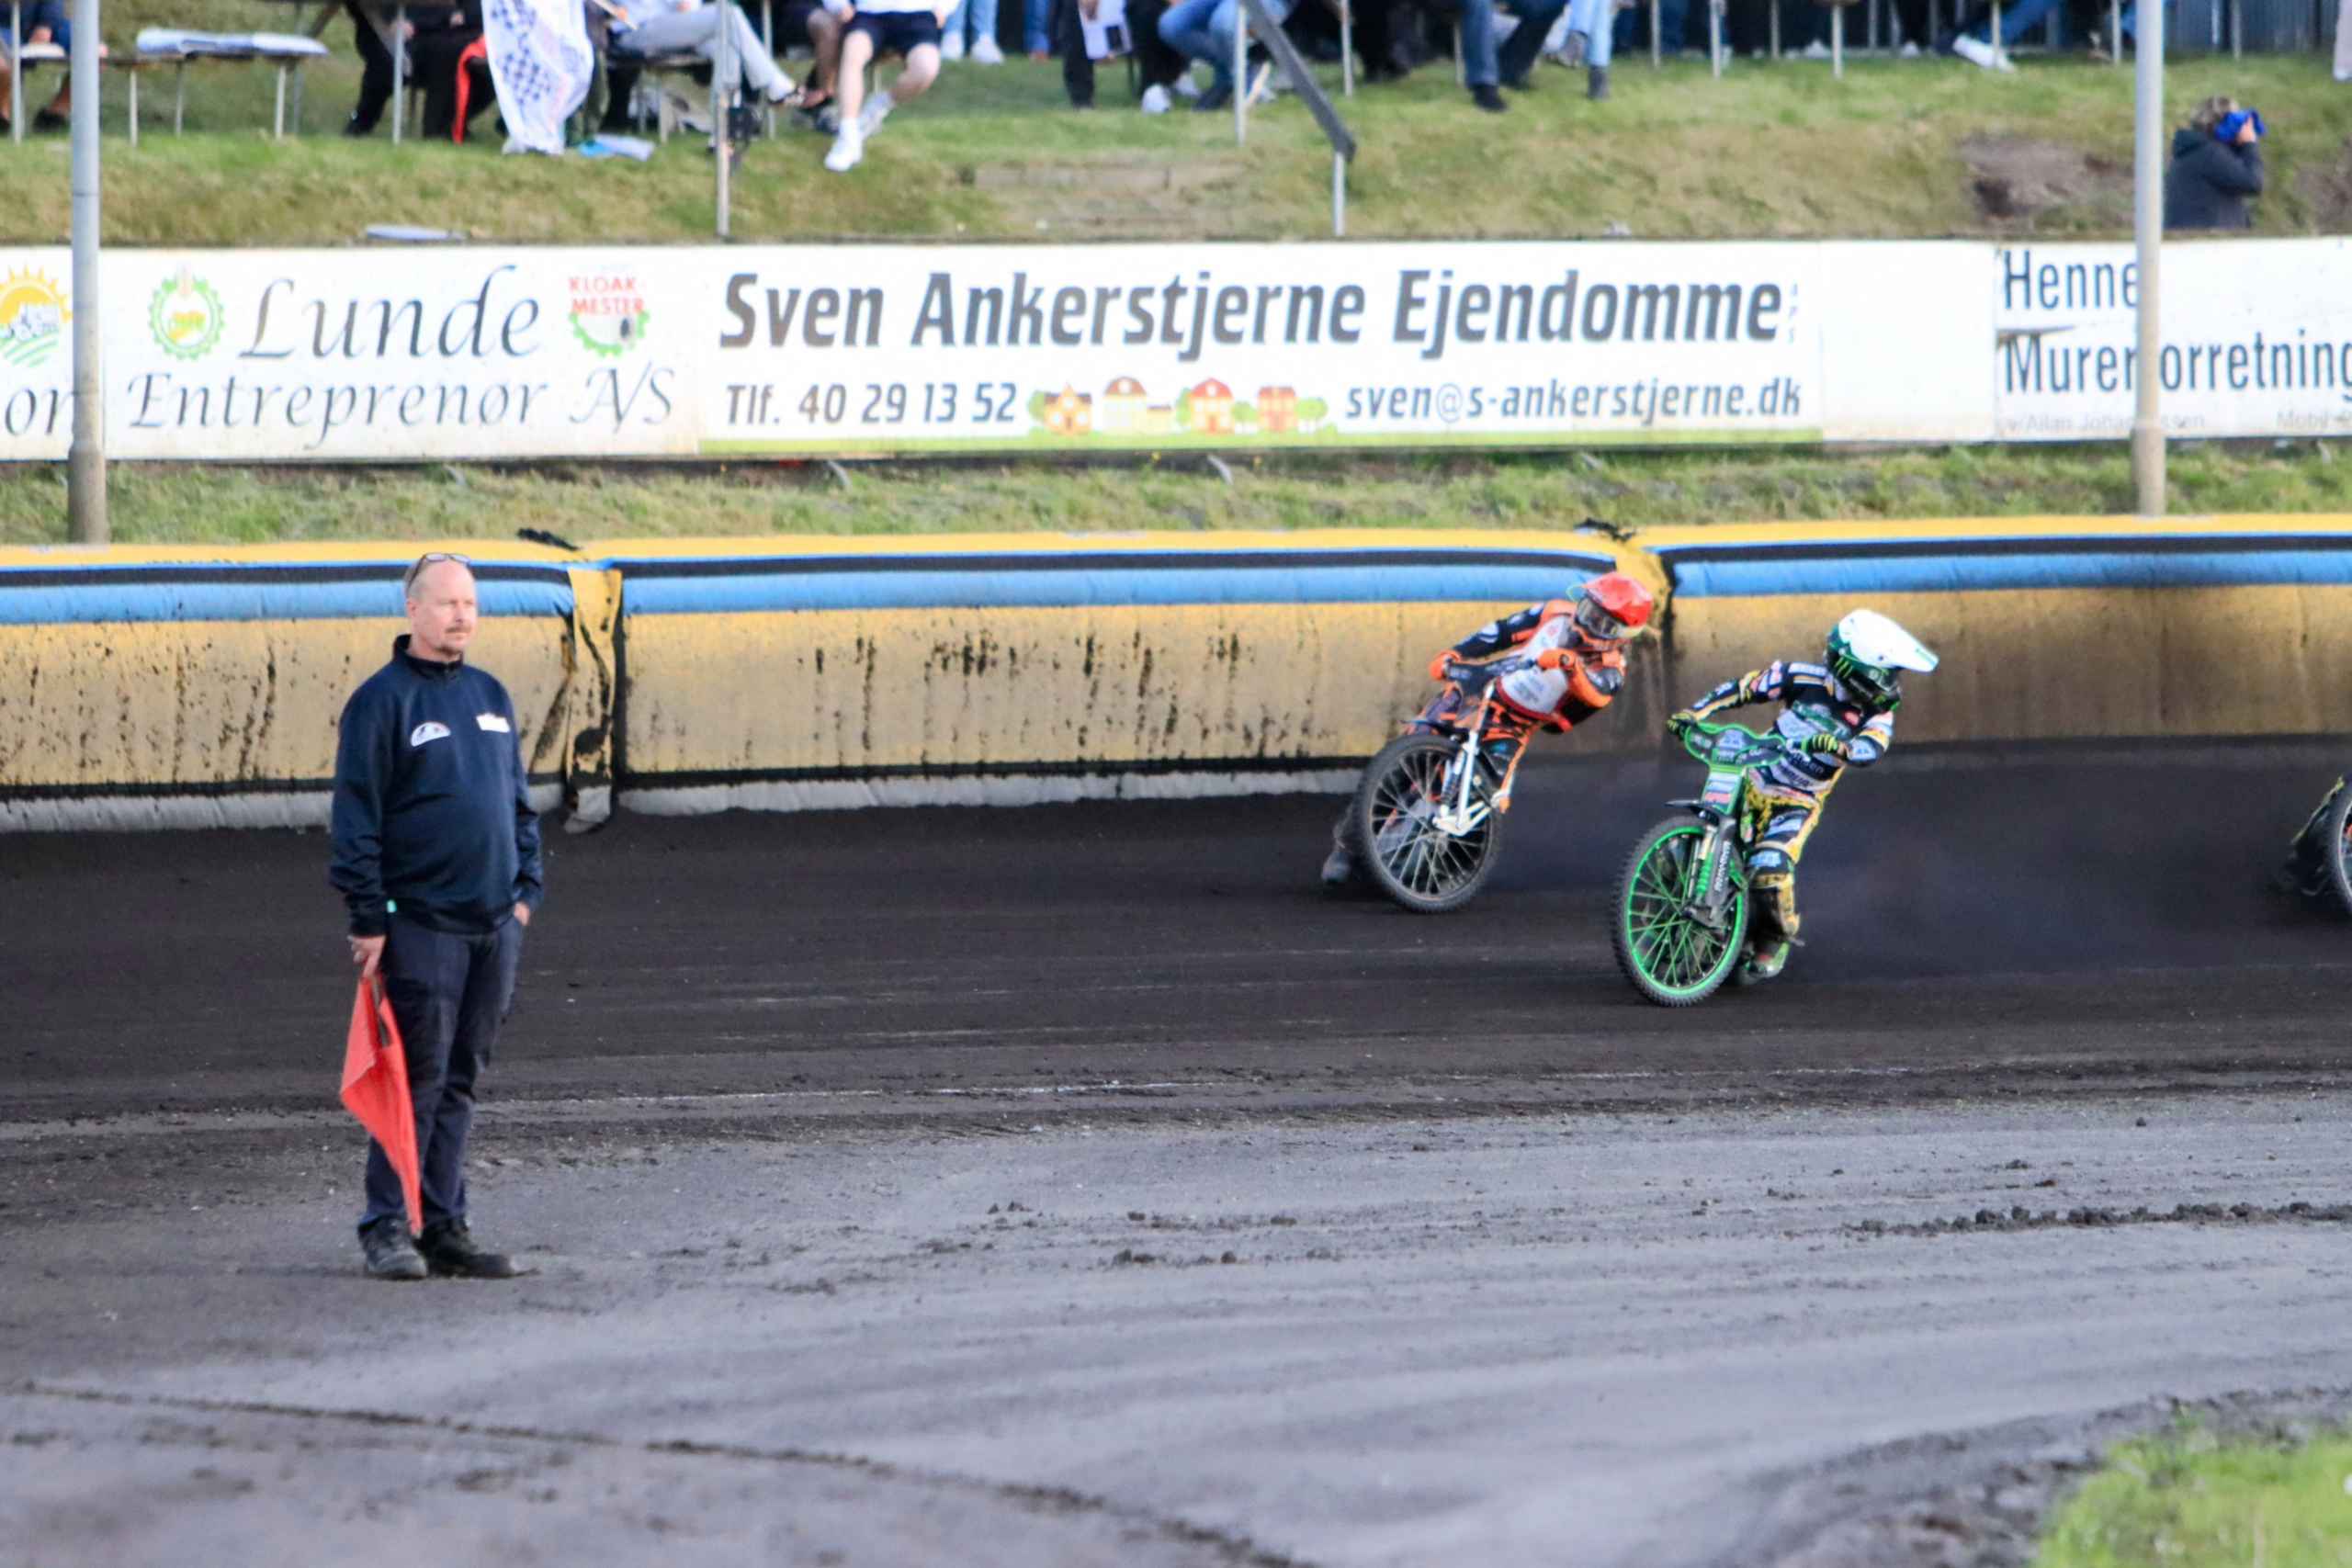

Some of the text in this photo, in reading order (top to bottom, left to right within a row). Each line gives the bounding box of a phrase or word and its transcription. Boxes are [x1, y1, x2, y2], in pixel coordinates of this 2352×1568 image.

[569, 276, 636, 292] KLOAK
[572, 298, 644, 313] MESTER
[2004, 250, 2138, 310] Henne
[239, 265, 538, 359] Lunde
[720, 269, 1781, 362] Sven Ankerstjerne Ejendomme
[2005, 329, 2352, 401] Murerorretning
[728, 382, 1017, 425] Tlf. 40 29 13 52
[1346, 377, 1802, 426] sven@s-ankerstjerne.dk
